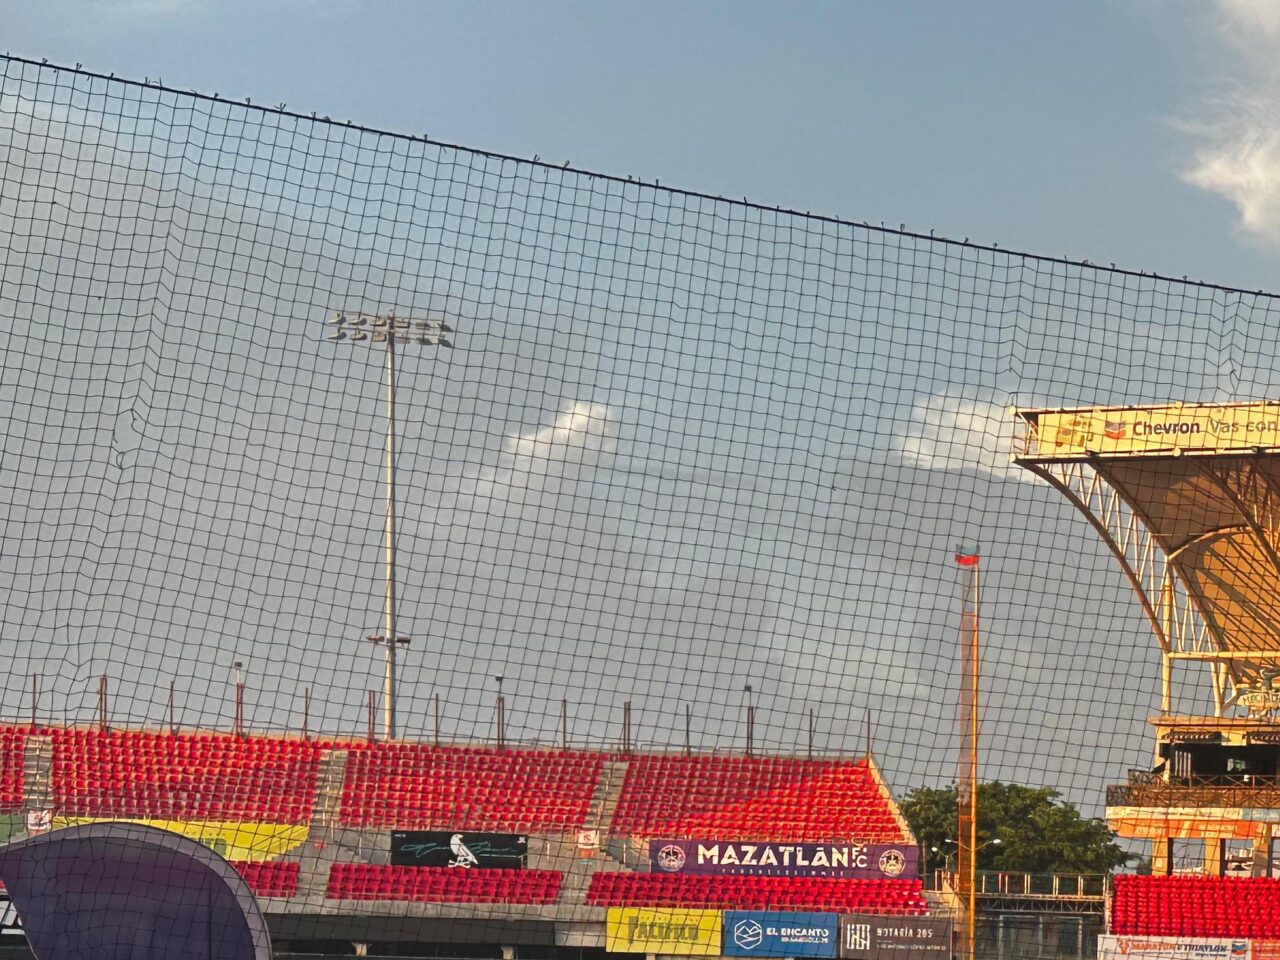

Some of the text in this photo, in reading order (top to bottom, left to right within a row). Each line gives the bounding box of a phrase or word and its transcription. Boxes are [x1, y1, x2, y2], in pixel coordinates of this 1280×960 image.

[1133, 420, 1201, 436] Chevron
[1210, 418, 1239, 433] Vas
[1246, 420, 1276, 433] con
[697, 844, 849, 868] MAZATLÁN
[915, 928, 933, 939] 205
